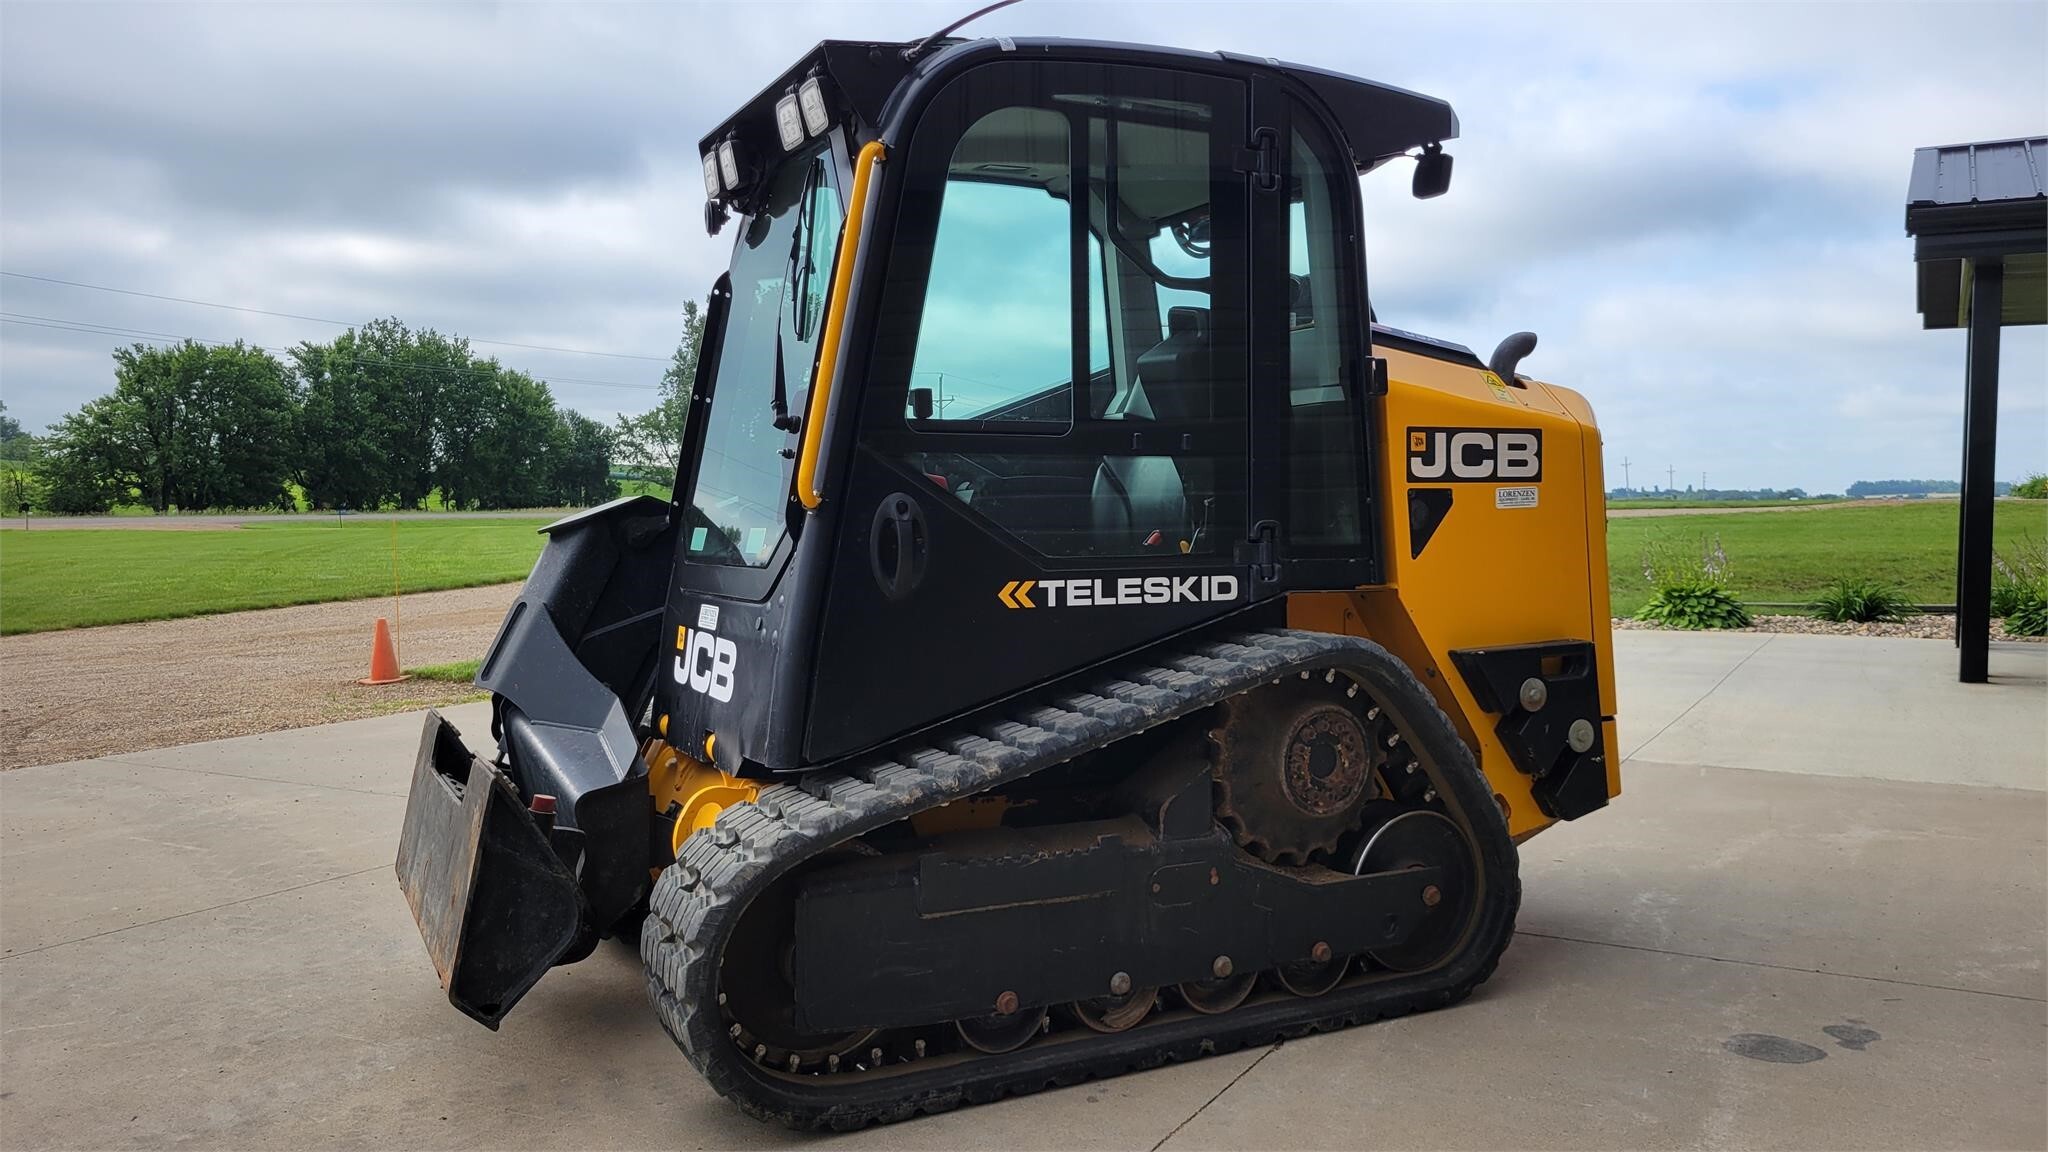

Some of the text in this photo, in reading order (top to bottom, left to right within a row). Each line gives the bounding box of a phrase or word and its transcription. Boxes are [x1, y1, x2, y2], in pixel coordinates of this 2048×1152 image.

[1411, 432, 1539, 478] JCB
[1498, 490, 1536, 498] LORENZEN
[1038, 575, 1238, 607] TELESKID
[674, 628, 737, 703] JCB
